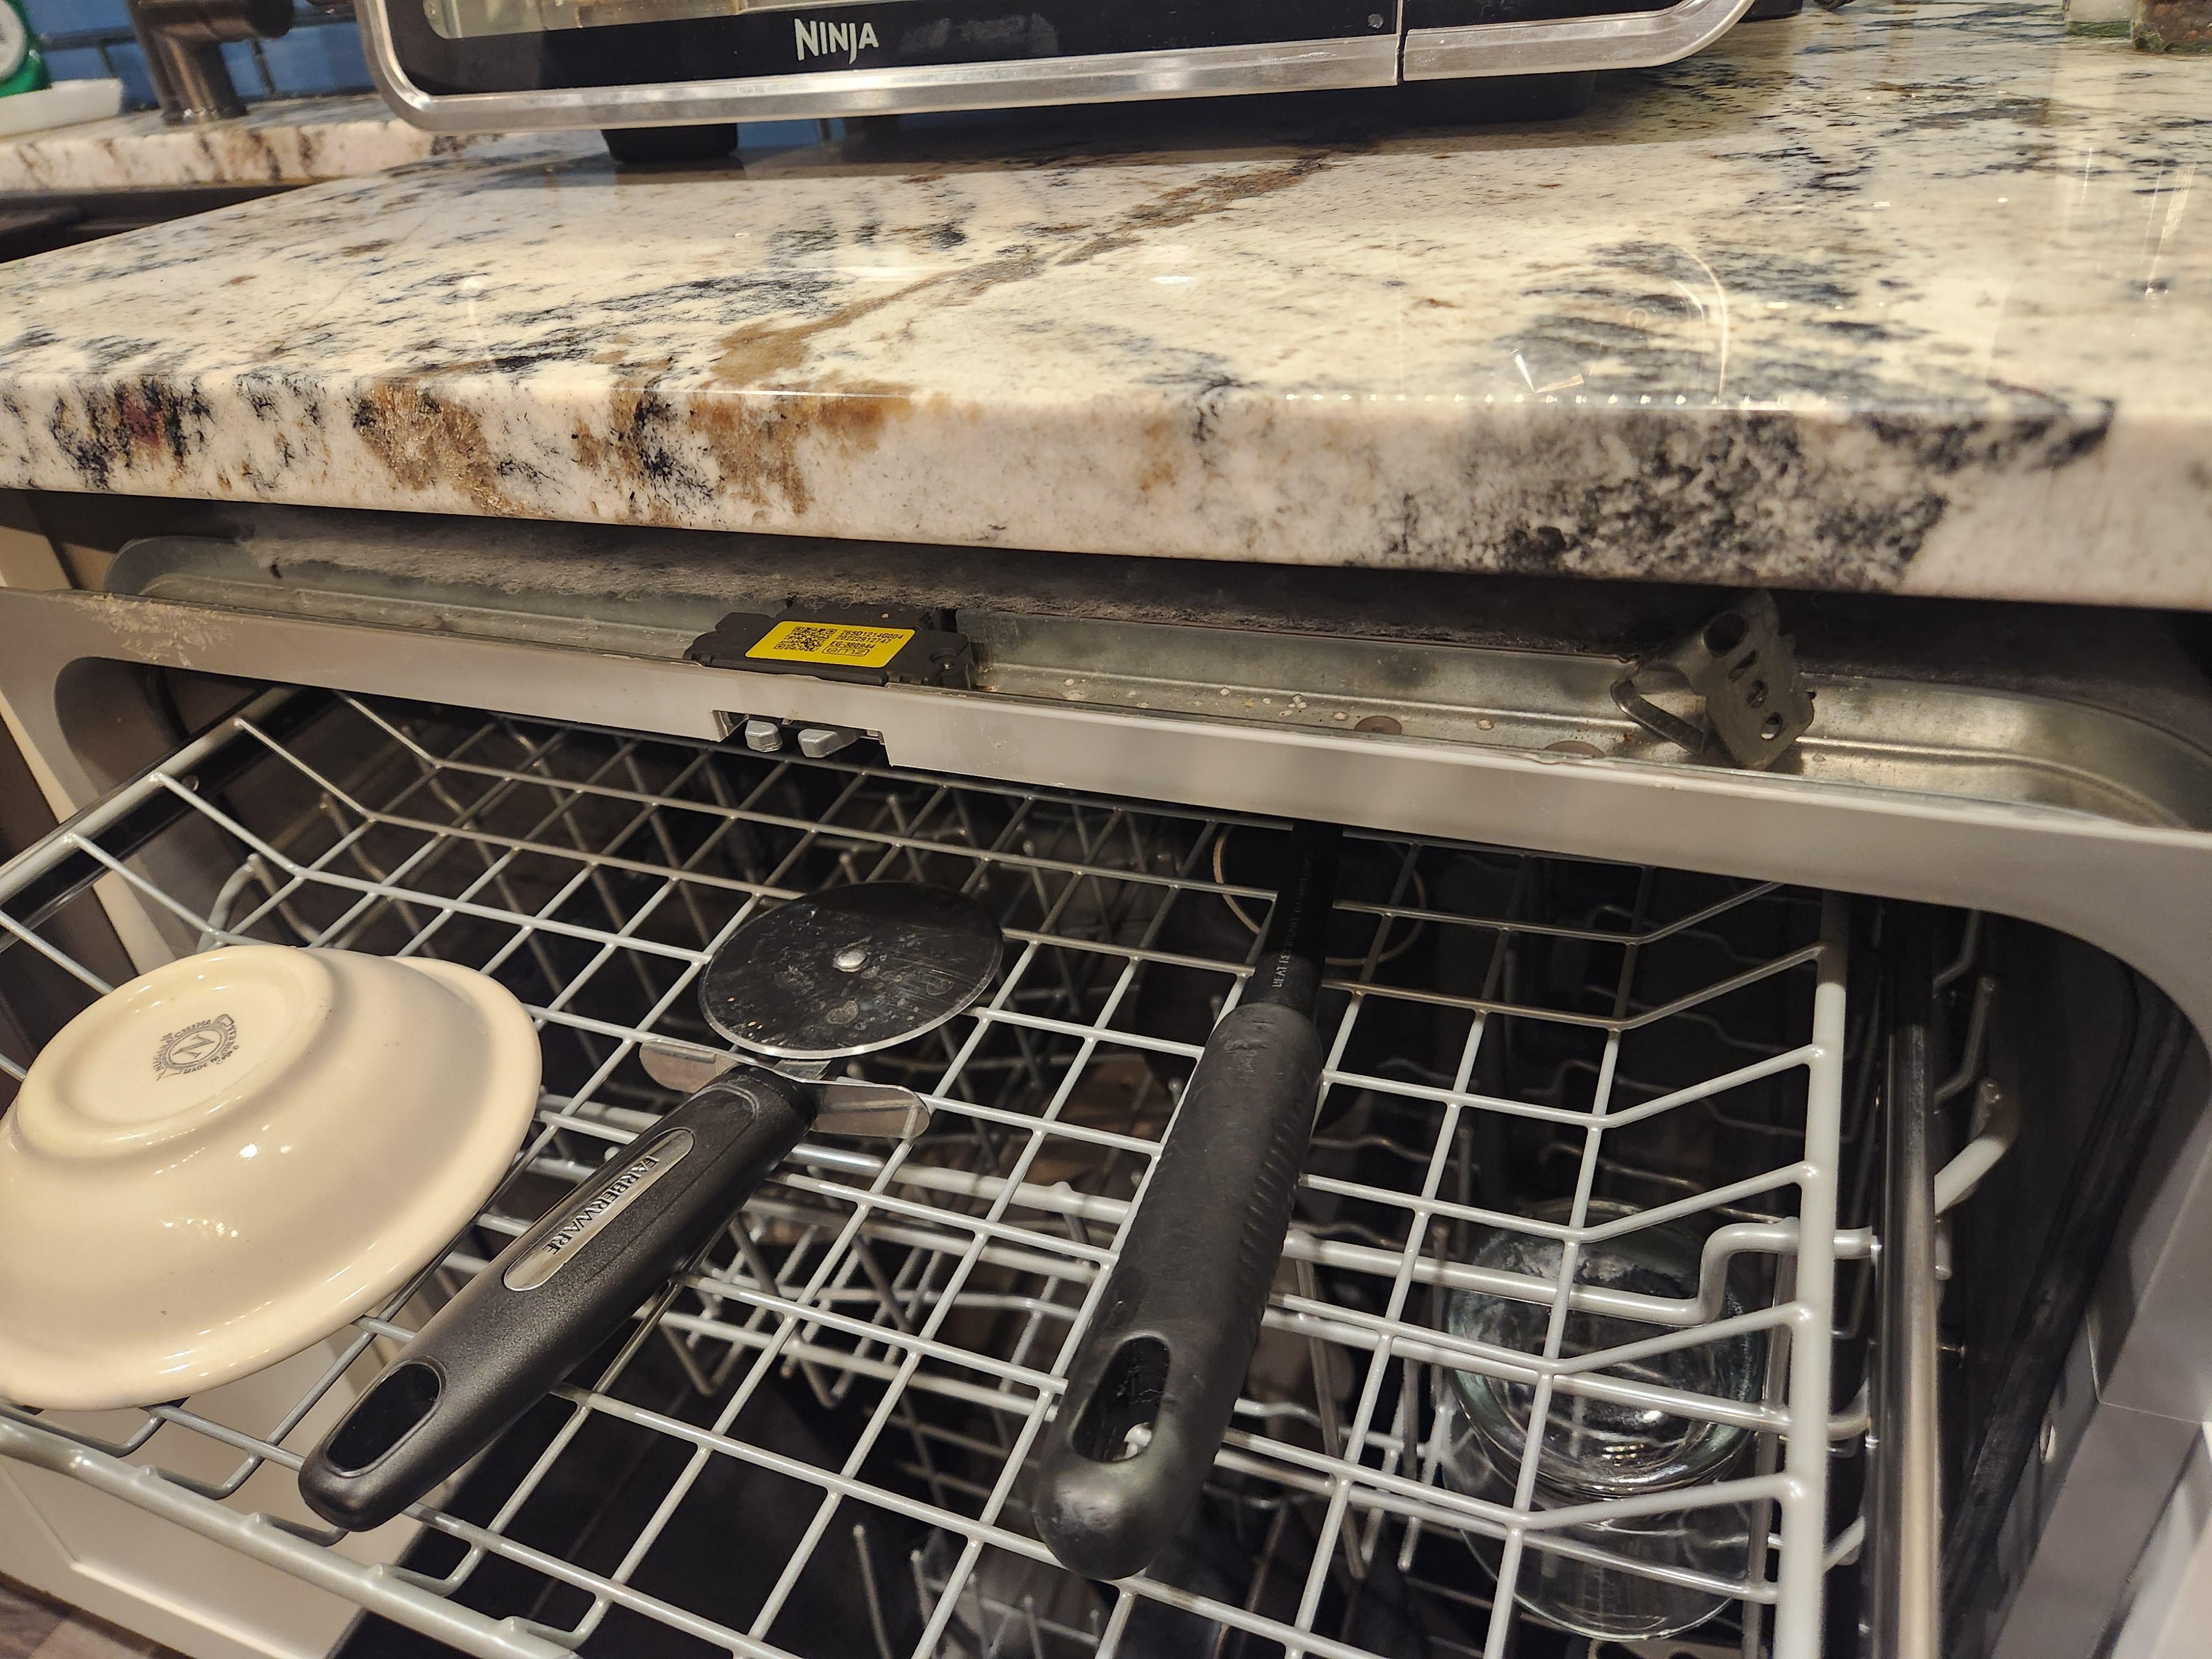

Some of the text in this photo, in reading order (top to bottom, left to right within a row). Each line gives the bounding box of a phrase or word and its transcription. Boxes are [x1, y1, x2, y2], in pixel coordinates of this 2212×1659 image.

[794, 18, 879, 64] NINJA
[834, 635, 893, 644] 20222912747
[841, 630, 904, 639] 265D1214G004
[152, 1019, 211, 1073] NIAGARA CHINA
[183, 1062, 209, 1075] MADE
[542, 1155, 660, 1255] FARBERWARE
